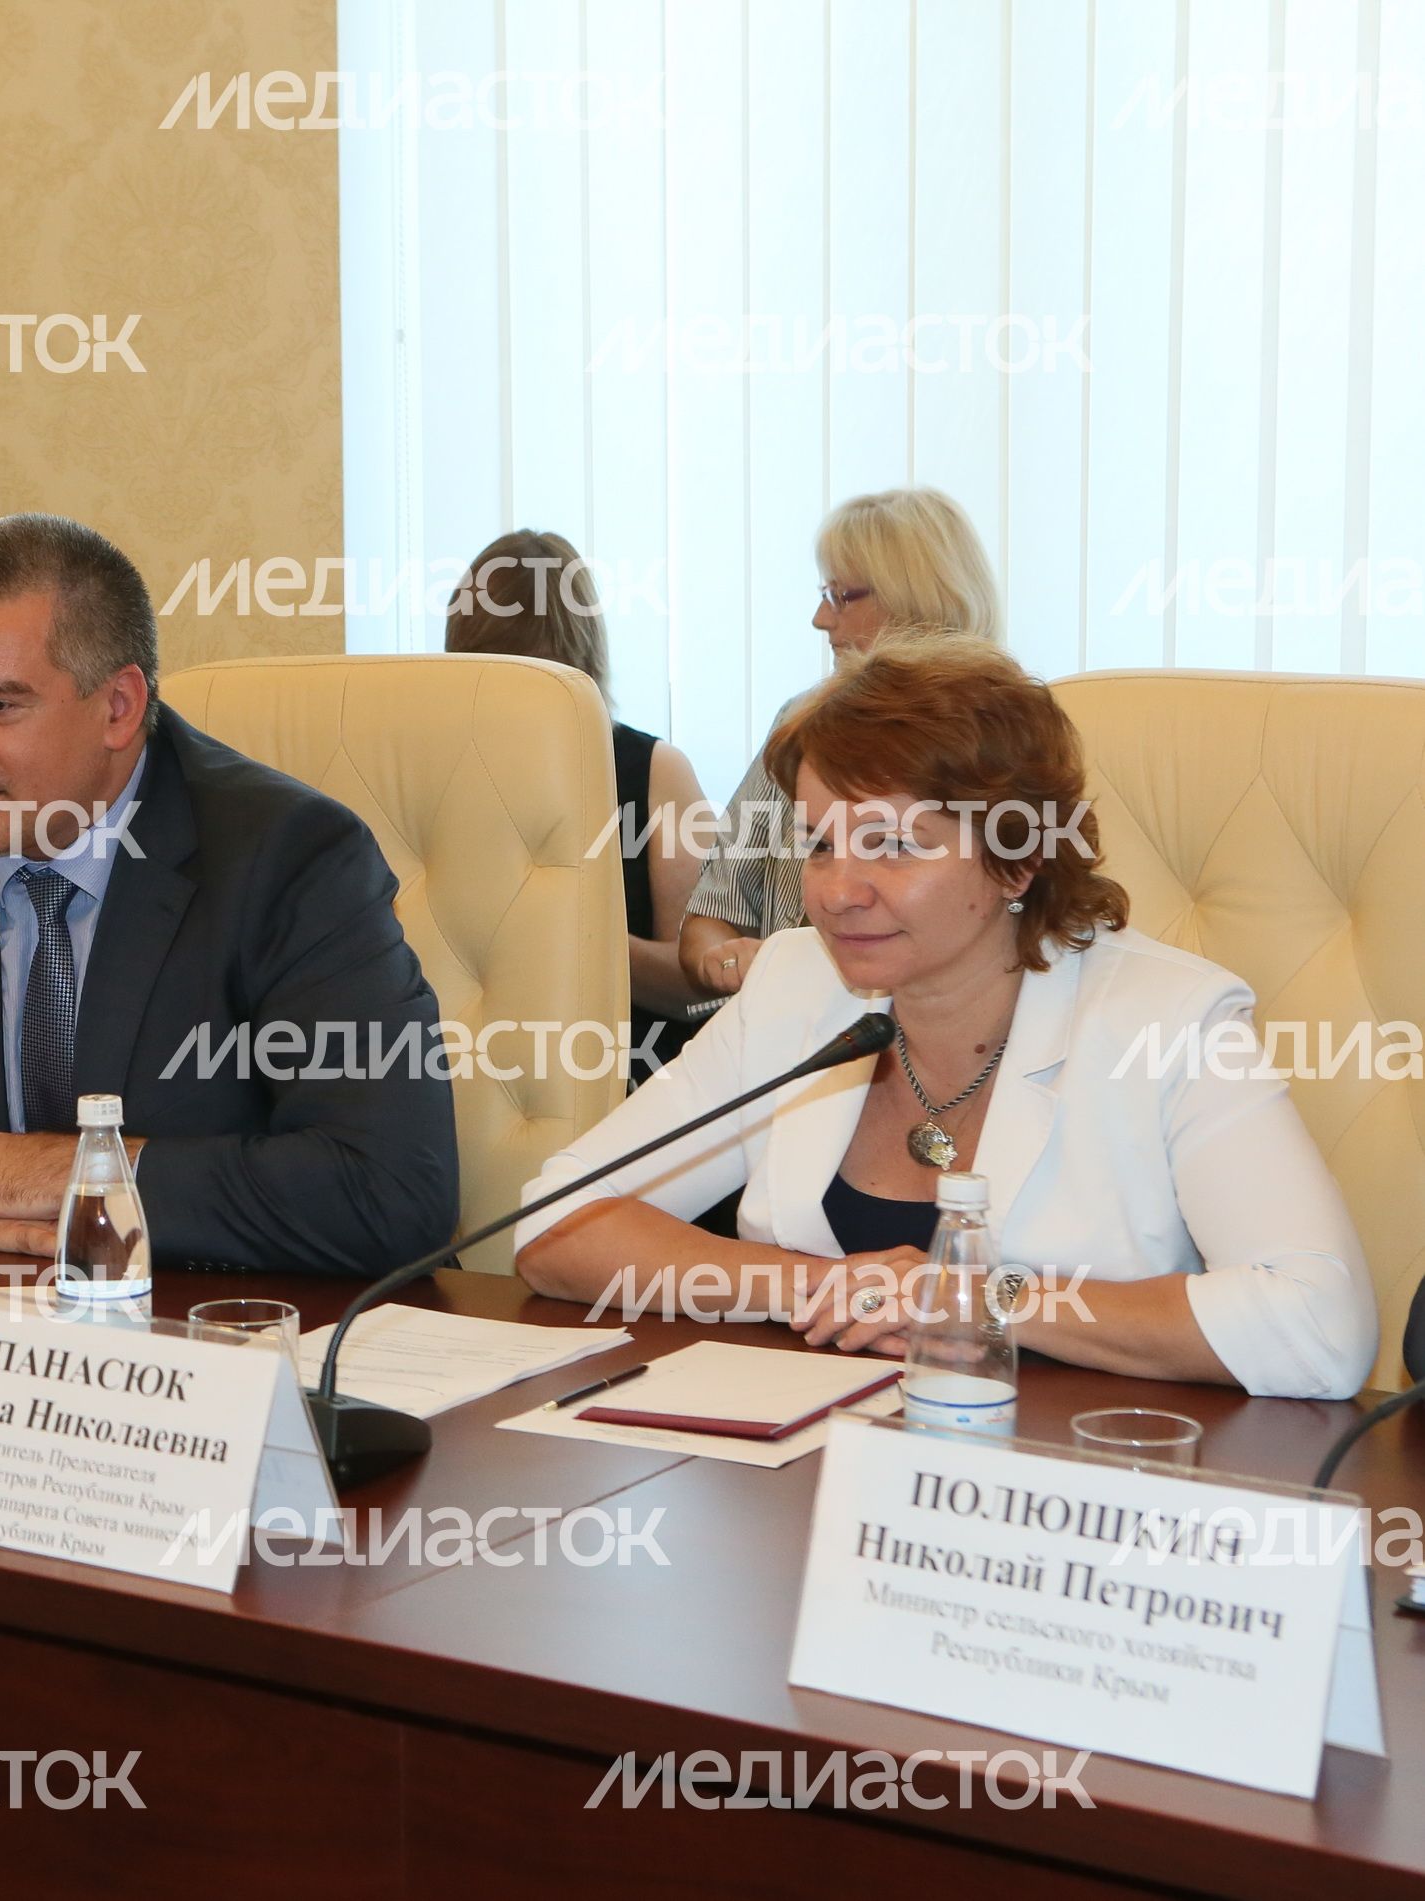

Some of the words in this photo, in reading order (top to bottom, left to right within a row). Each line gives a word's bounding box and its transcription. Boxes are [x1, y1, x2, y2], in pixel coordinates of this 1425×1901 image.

[26, 1398, 229, 1463] Николаевна
[42, 1474, 135, 1506] Республики
[138, 1493, 186, 1518] Крым
[48, 1448, 157, 1484] Председателя
[60, 1531, 106, 1557] Крым
[63, 1505, 119, 1532] Совета
[910, 1471, 1244, 1565] ПОЛЮШКИН
[856, 1522, 1045, 1594] Николай
[1060, 1561, 1285, 1639] Петрович
[864, 1579, 980, 1628] Министр
[985, 1604, 1115, 1652] сельского
[1120, 1639, 1257, 1682] хозяйства
[930, 1630, 1085, 1686] Республики
[1091, 1664, 1170, 1703] Крым
